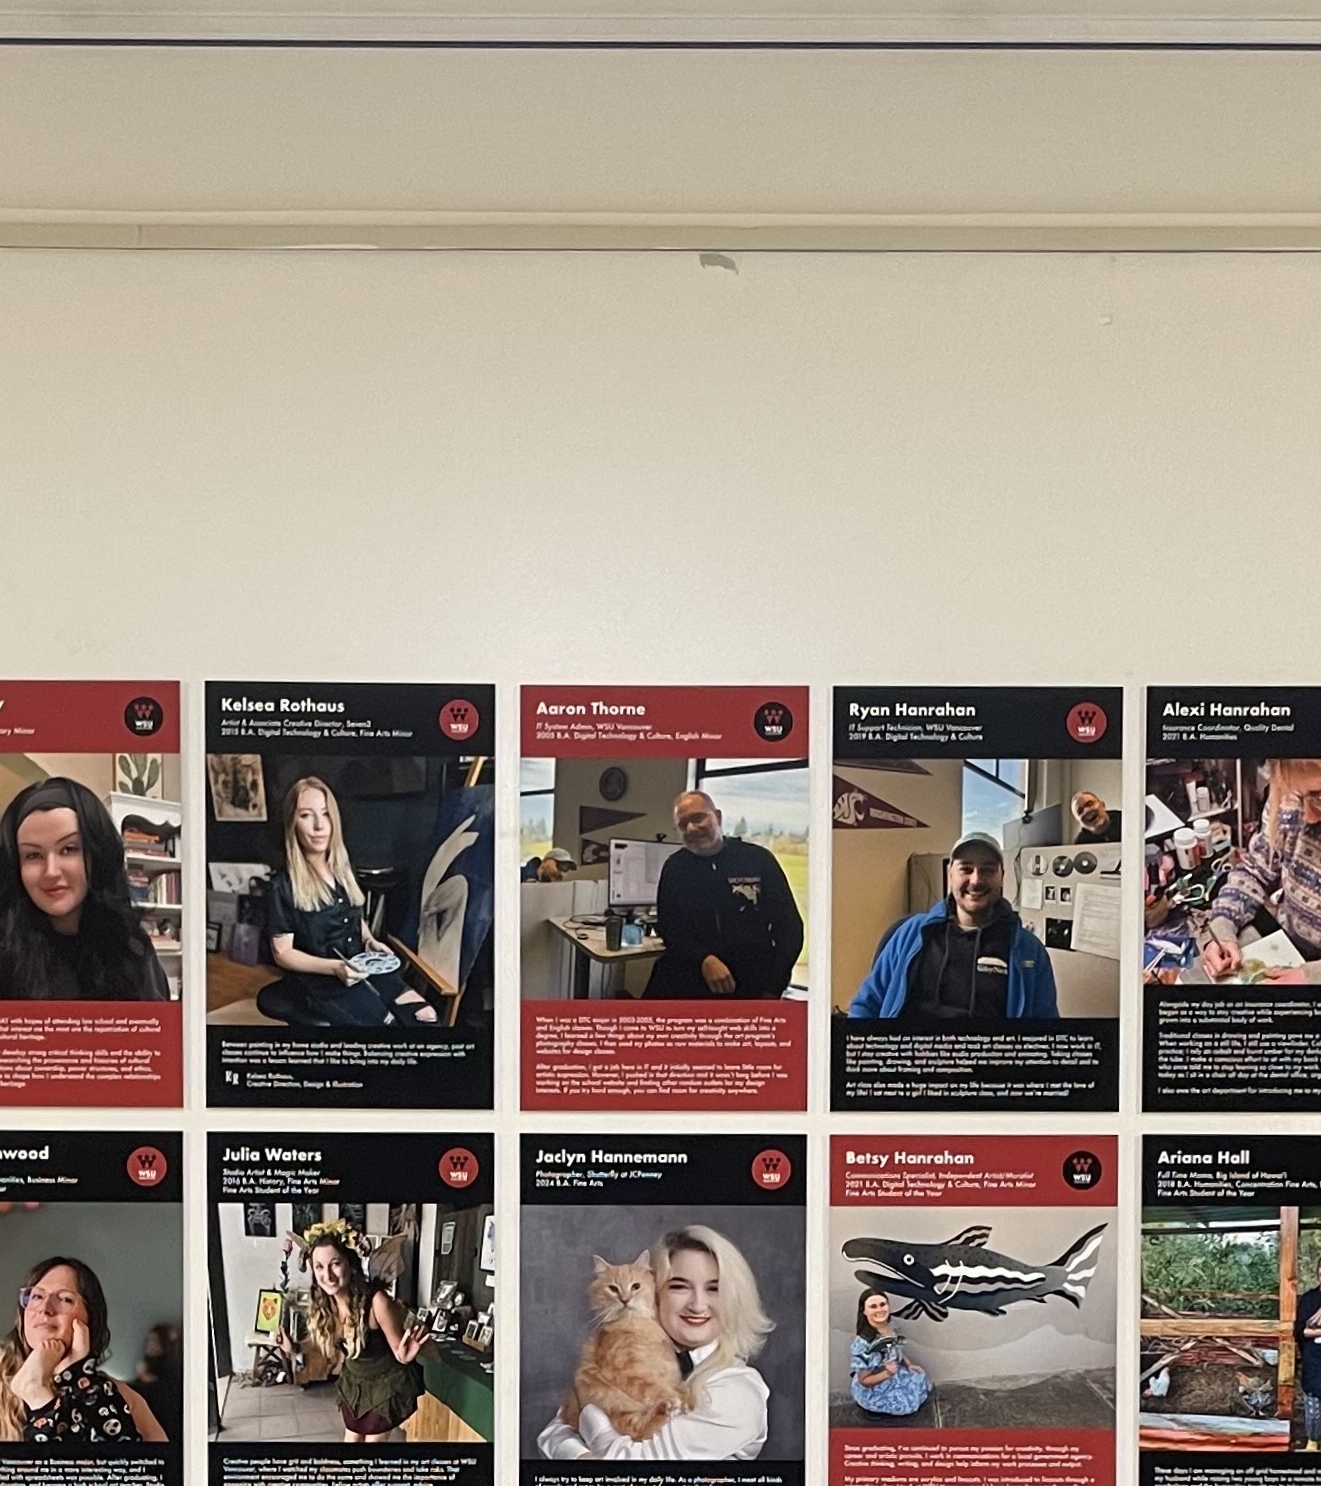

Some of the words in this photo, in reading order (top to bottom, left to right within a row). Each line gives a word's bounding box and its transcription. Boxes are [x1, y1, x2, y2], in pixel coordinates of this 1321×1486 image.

[222, 697, 274, 711] Kelsea
[280, 698, 344, 712] Rothaus
[537, 702, 586, 715] Aaron
[591, 701, 645, 715] Thorne
[850, 703, 890, 719] Ryan
[895, 702, 975, 716] Hanrahan
[1163, 702, 1204, 716] Alexi
[1210, 702, 1290, 716] Hanrahan
[868, 732, 882, 740] B.A.
[223, 1147, 260, 1161] Julia
[265, 1148, 321, 1161] Waters
[536, 1149, 586, 1166] Jaclyn
[591, 1150, 687, 1163] Hannemann
[846, 1151, 889, 1167] Betsy
[895, 1151, 974, 1164] Hanrahan
[1158, 1151, 1212, 1164] Ariana
[1218, 1150, 1249, 1164] Hall
